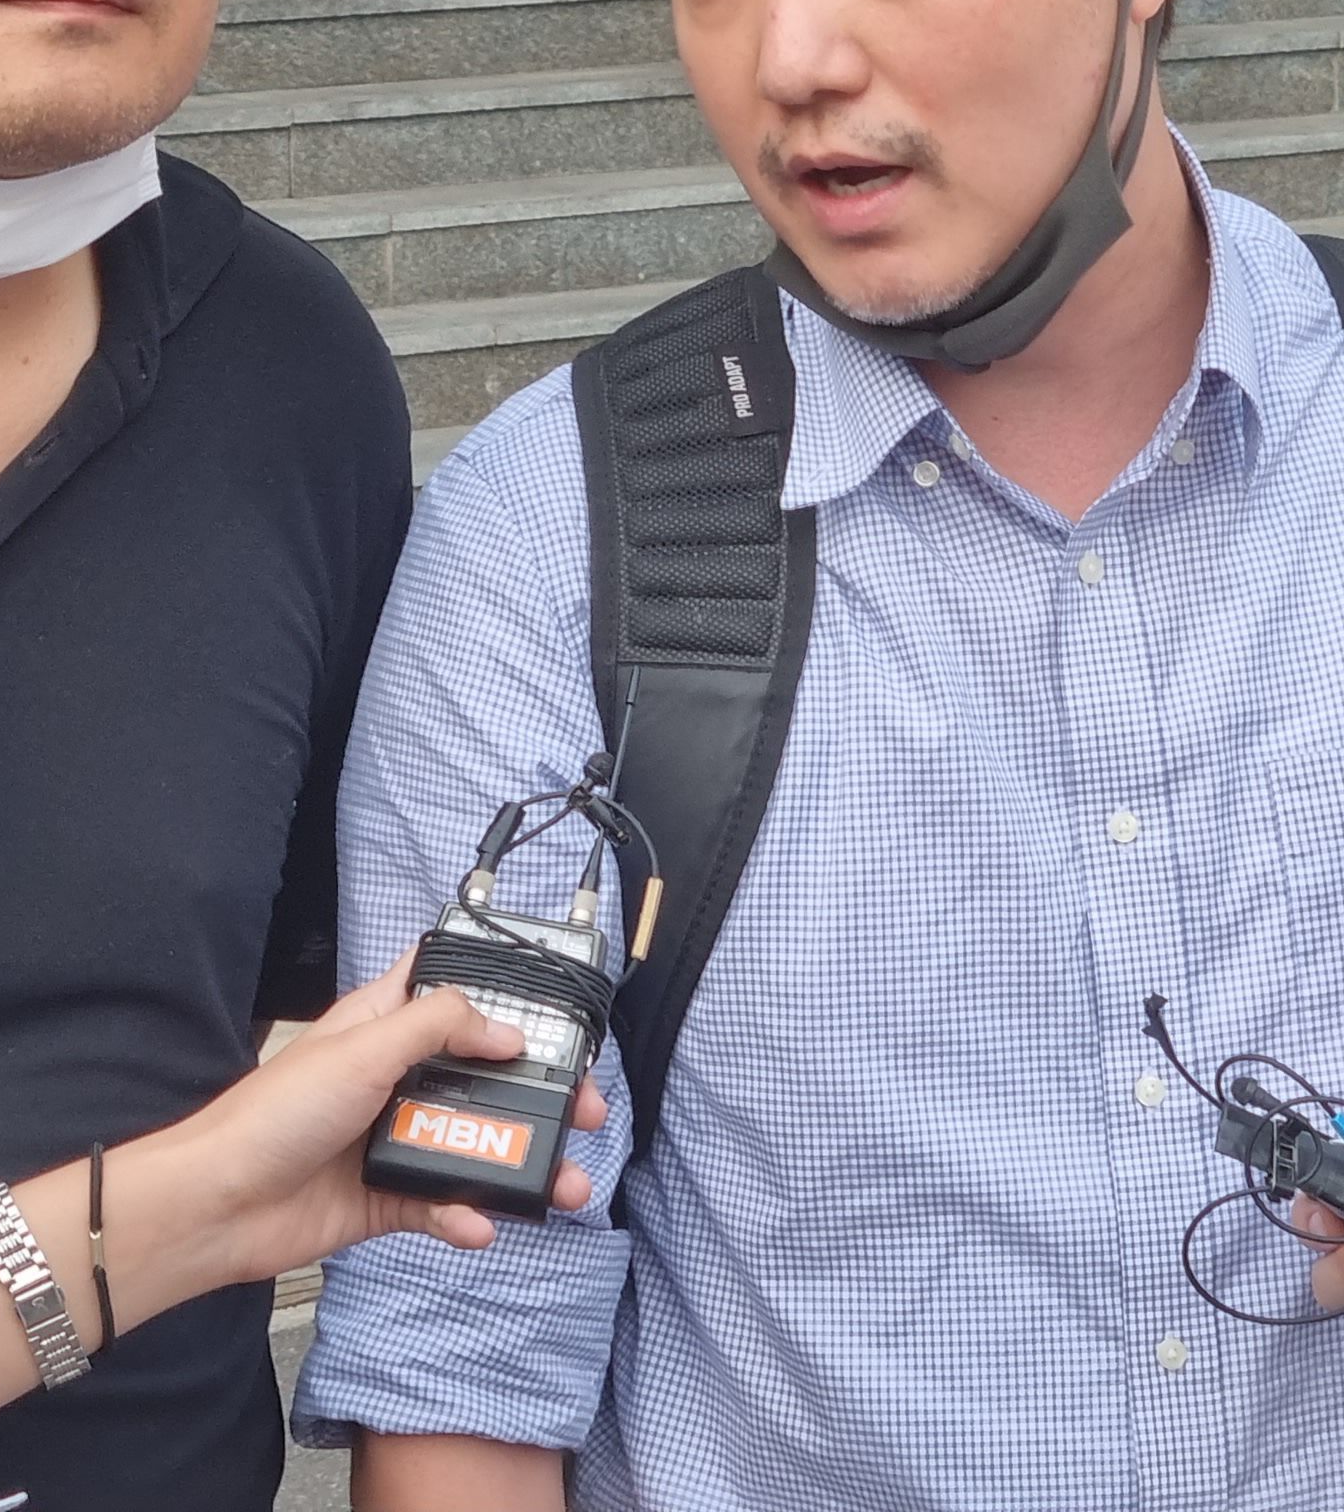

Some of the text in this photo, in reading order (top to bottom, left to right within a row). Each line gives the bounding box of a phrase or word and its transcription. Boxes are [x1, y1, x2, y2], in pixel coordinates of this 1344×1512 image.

[722, 356, 754, 418] PRO ADAPT
[408, 1110, 513, 1157] MBN
